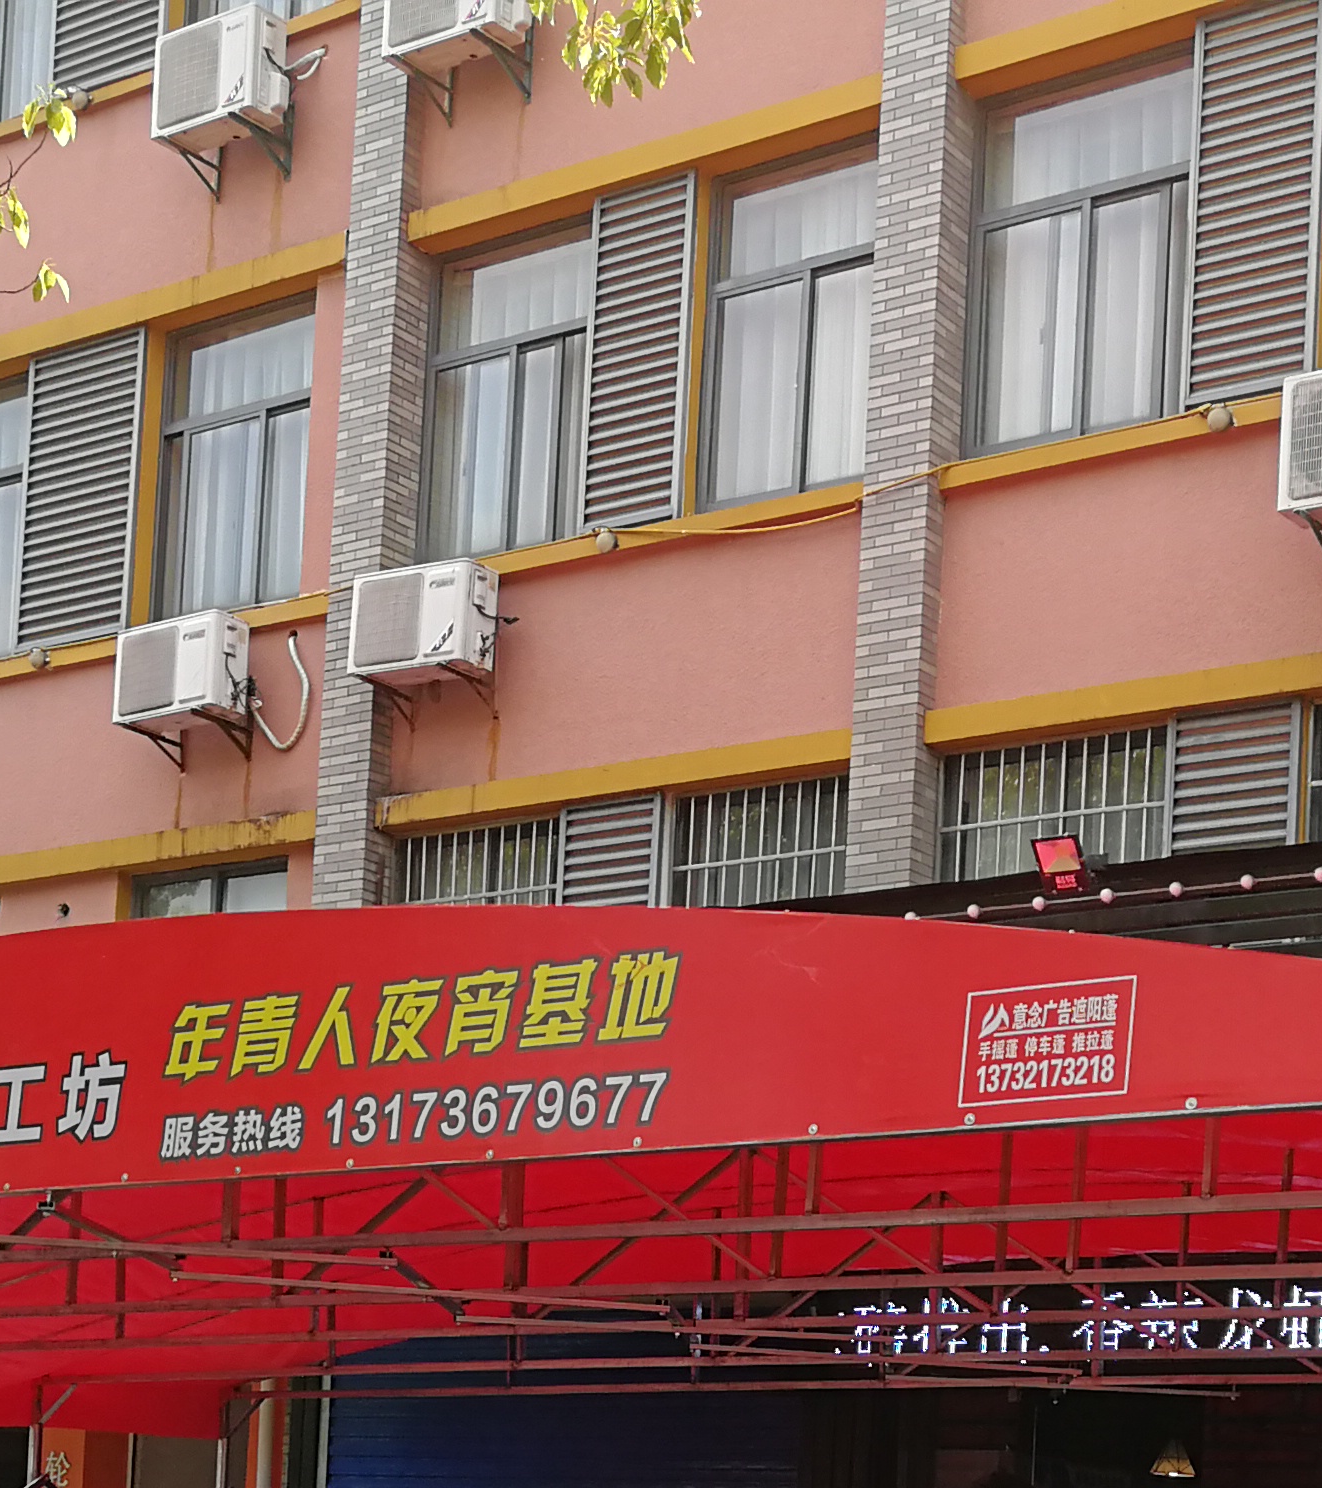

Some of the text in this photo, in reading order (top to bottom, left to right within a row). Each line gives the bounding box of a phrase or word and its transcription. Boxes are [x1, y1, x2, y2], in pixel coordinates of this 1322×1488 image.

[163, 949, 682, 1084] 年青人夜宵基地
[160, 1071, 670, 1161] 服务热线 13173679677
[976, 1053, 1115, 1094] 13732173218
